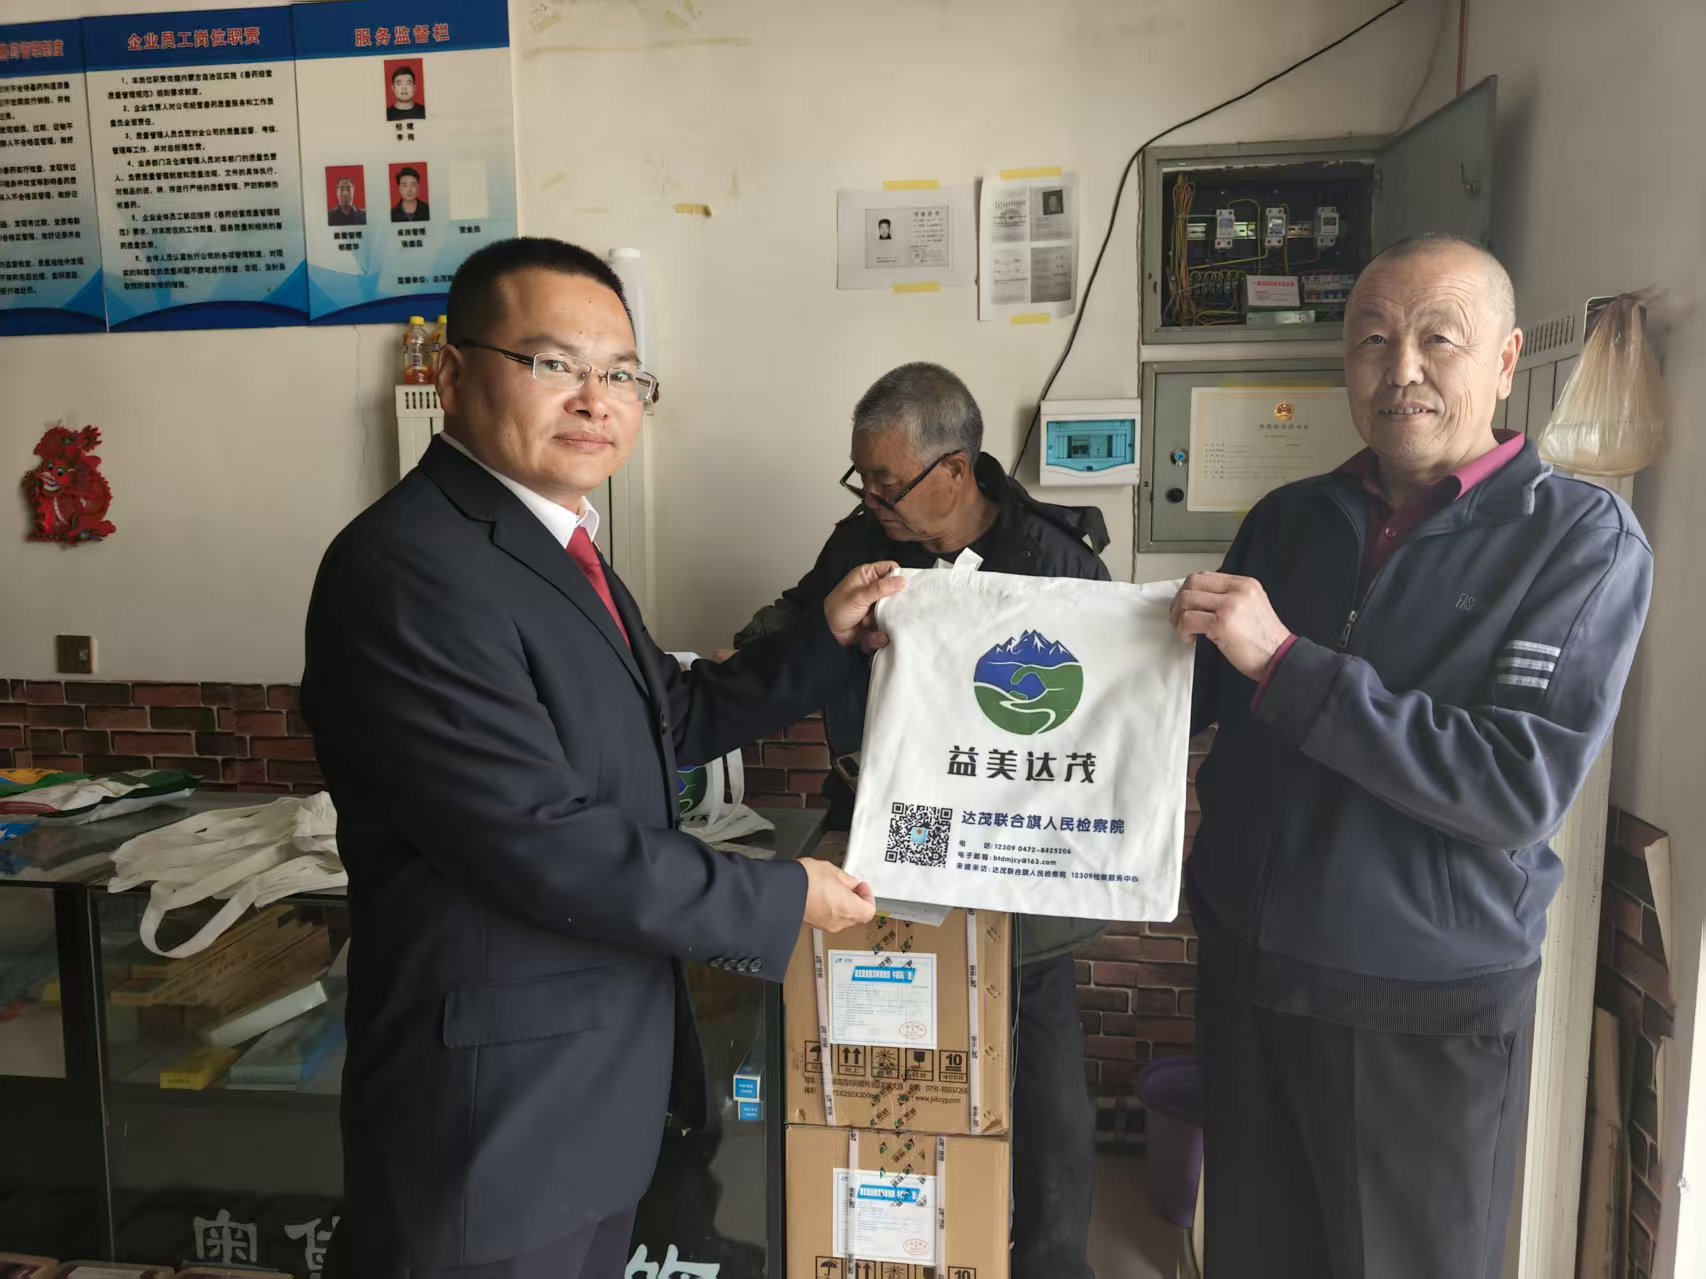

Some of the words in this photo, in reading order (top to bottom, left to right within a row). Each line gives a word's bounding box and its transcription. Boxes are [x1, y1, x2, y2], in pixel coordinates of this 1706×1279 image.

[128, 27, 261, 50] 企业员工岗位职责
[354, 23, 450, 47] 服务监督栏
[947, 745, 1096, 783] 益美达茂
[961, 810, 1126, 835] 达茂联合旗人民检察院
[1018, 845, 1072, 855] 0472-8425206
[945, 1053, 962, 1066] 10
